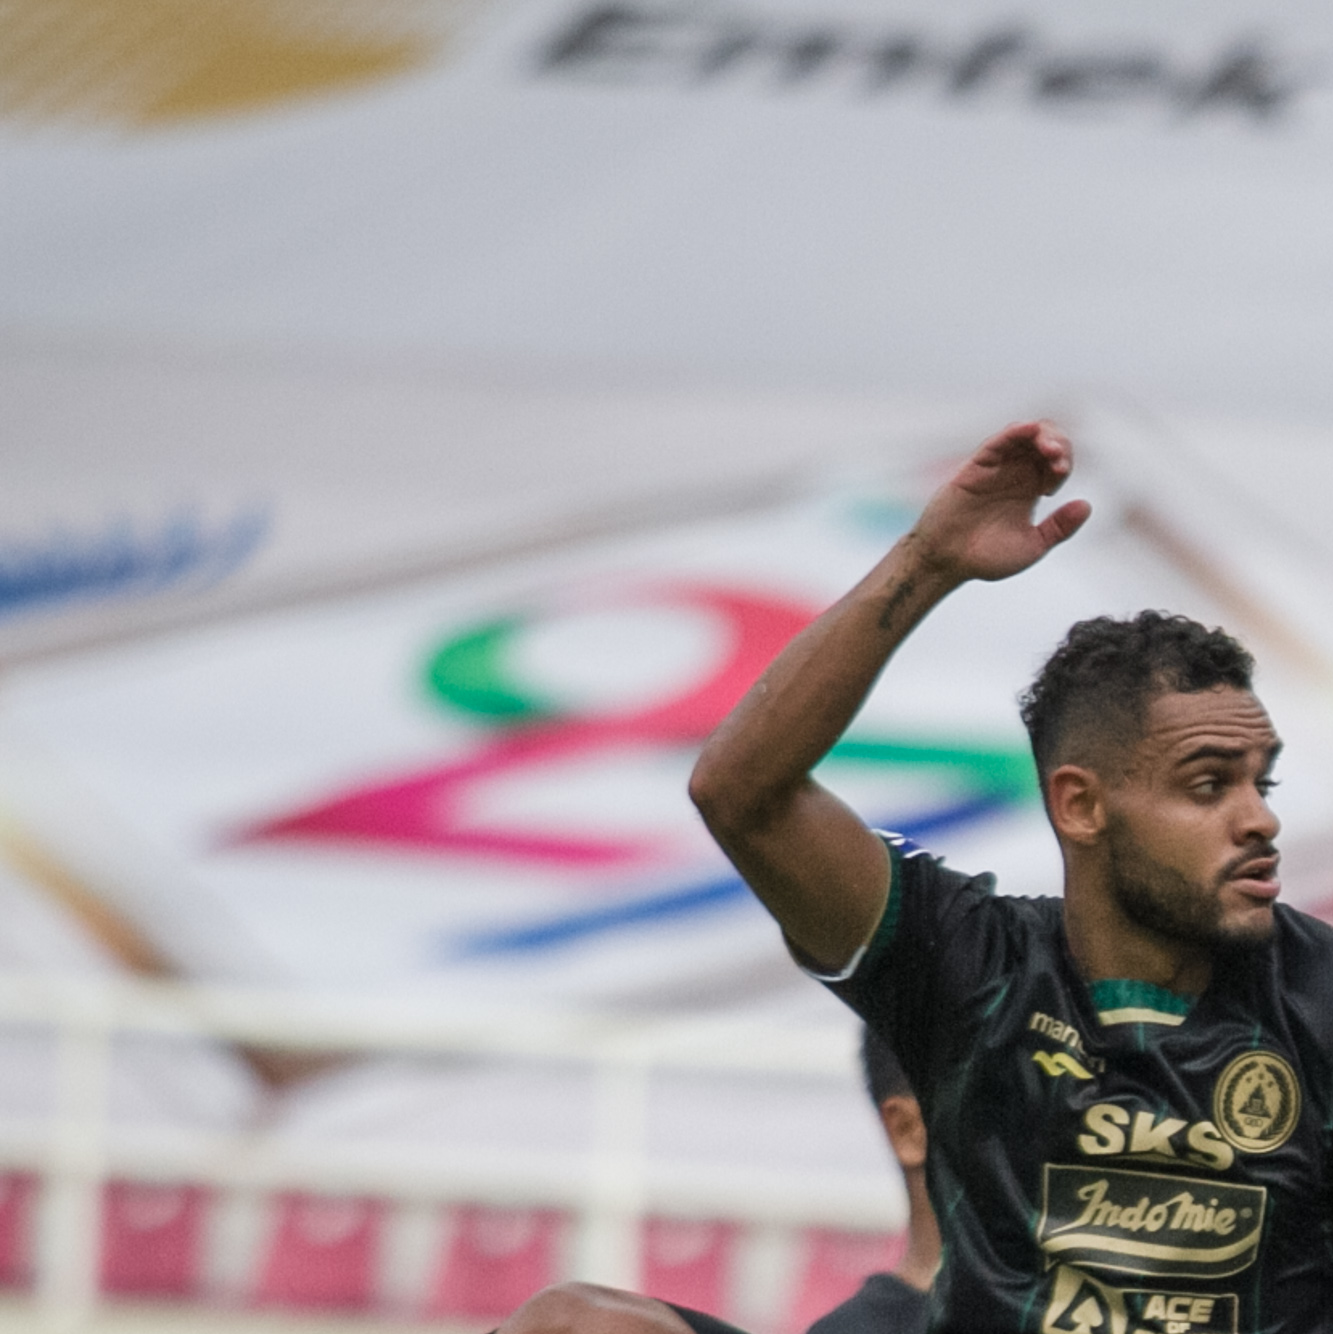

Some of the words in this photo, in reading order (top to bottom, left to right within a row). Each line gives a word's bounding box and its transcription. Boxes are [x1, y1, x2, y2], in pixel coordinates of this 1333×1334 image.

[1078, 1103, 1235, 1171] SKS
[1143, 1294, 1216, 1324] ACE
[1166, 1321, 1192, 1334] OF
